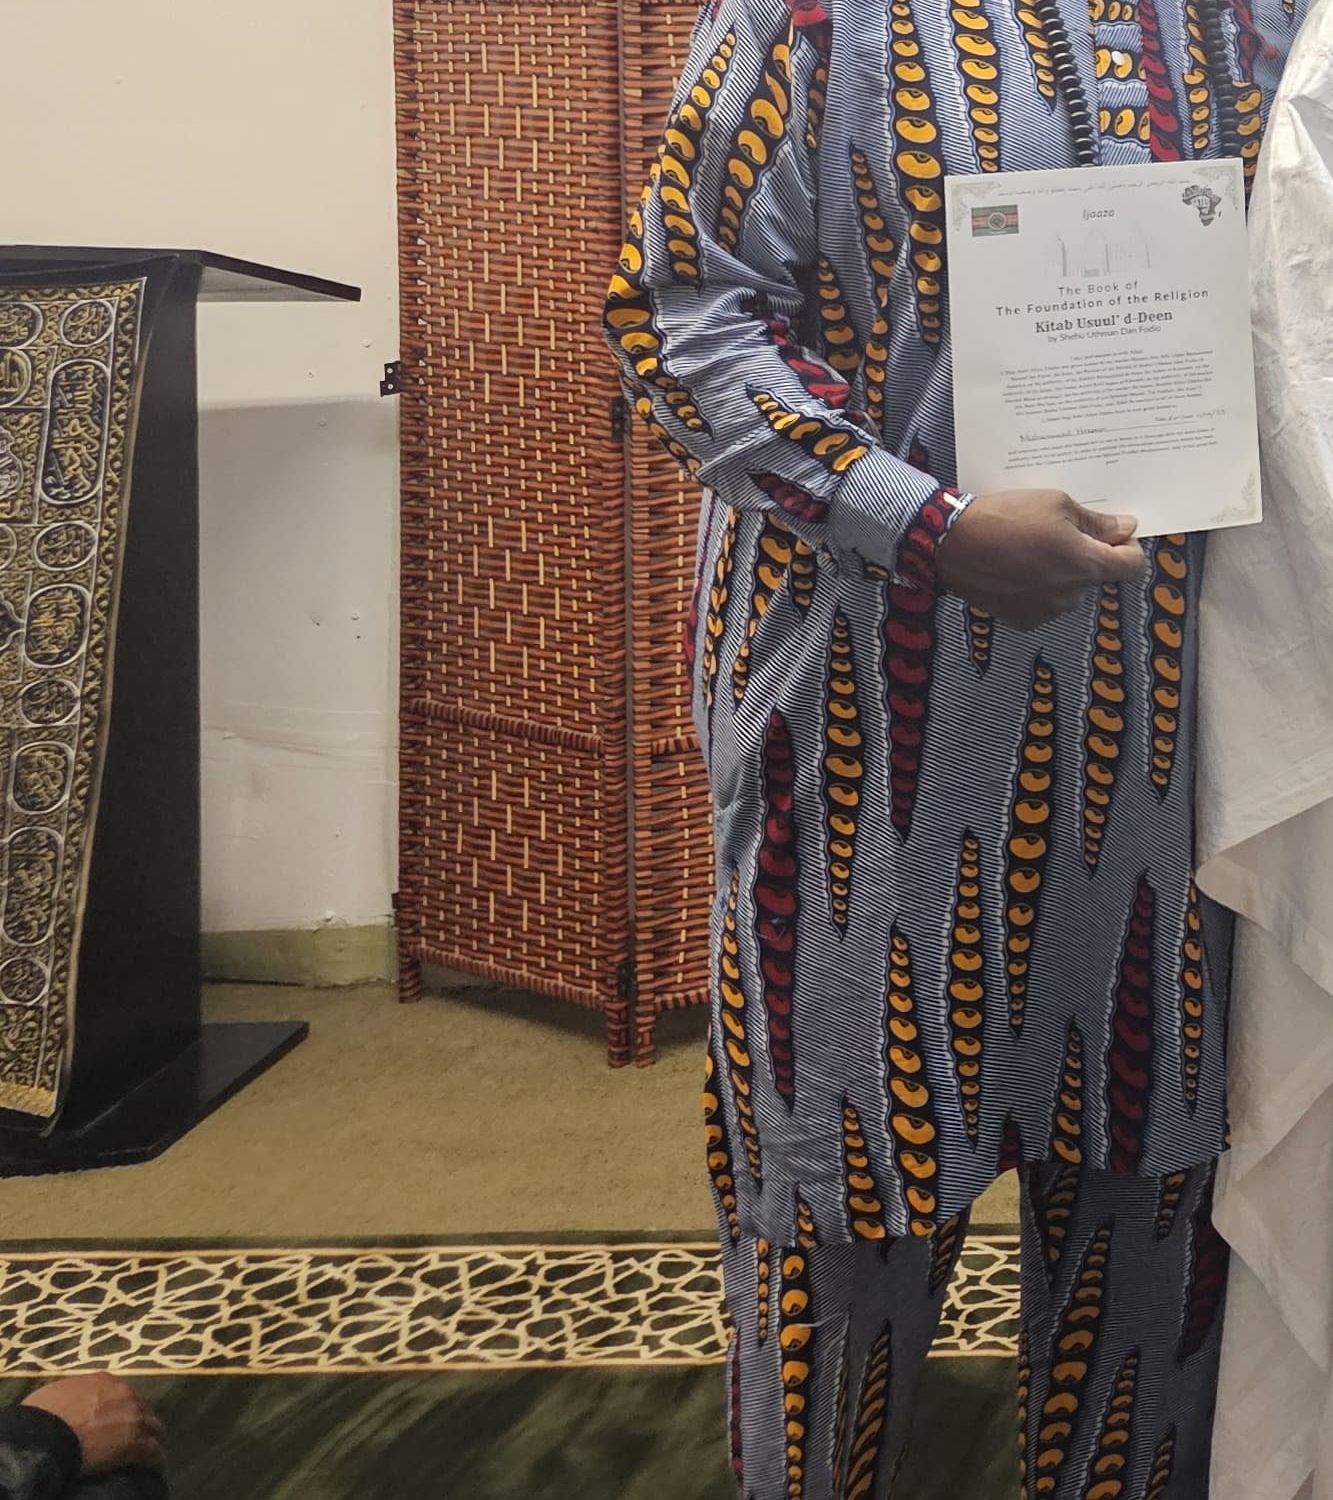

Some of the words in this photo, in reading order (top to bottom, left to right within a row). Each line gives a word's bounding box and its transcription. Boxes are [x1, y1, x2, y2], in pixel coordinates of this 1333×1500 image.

[1058, 286, 1081, 296] The
[1088, 282, 1120, 294] Book
[1126, 280, 1138, 290] of
[995, 306, 1020, 316] The
[1027, 298, 1103, 314] Foundation
[1109, 296, 1121, 306] of
[1128, 294, 1148, 304] the
[1154, 289, 1209, 302] Religion
[1034, 318, 1073, 334] Kitab
[1124, 310, 1173, 324] d-Deen
[1120, 326, 1138, 336] Dan
[1139, 324, 1161, 334] Fodio
